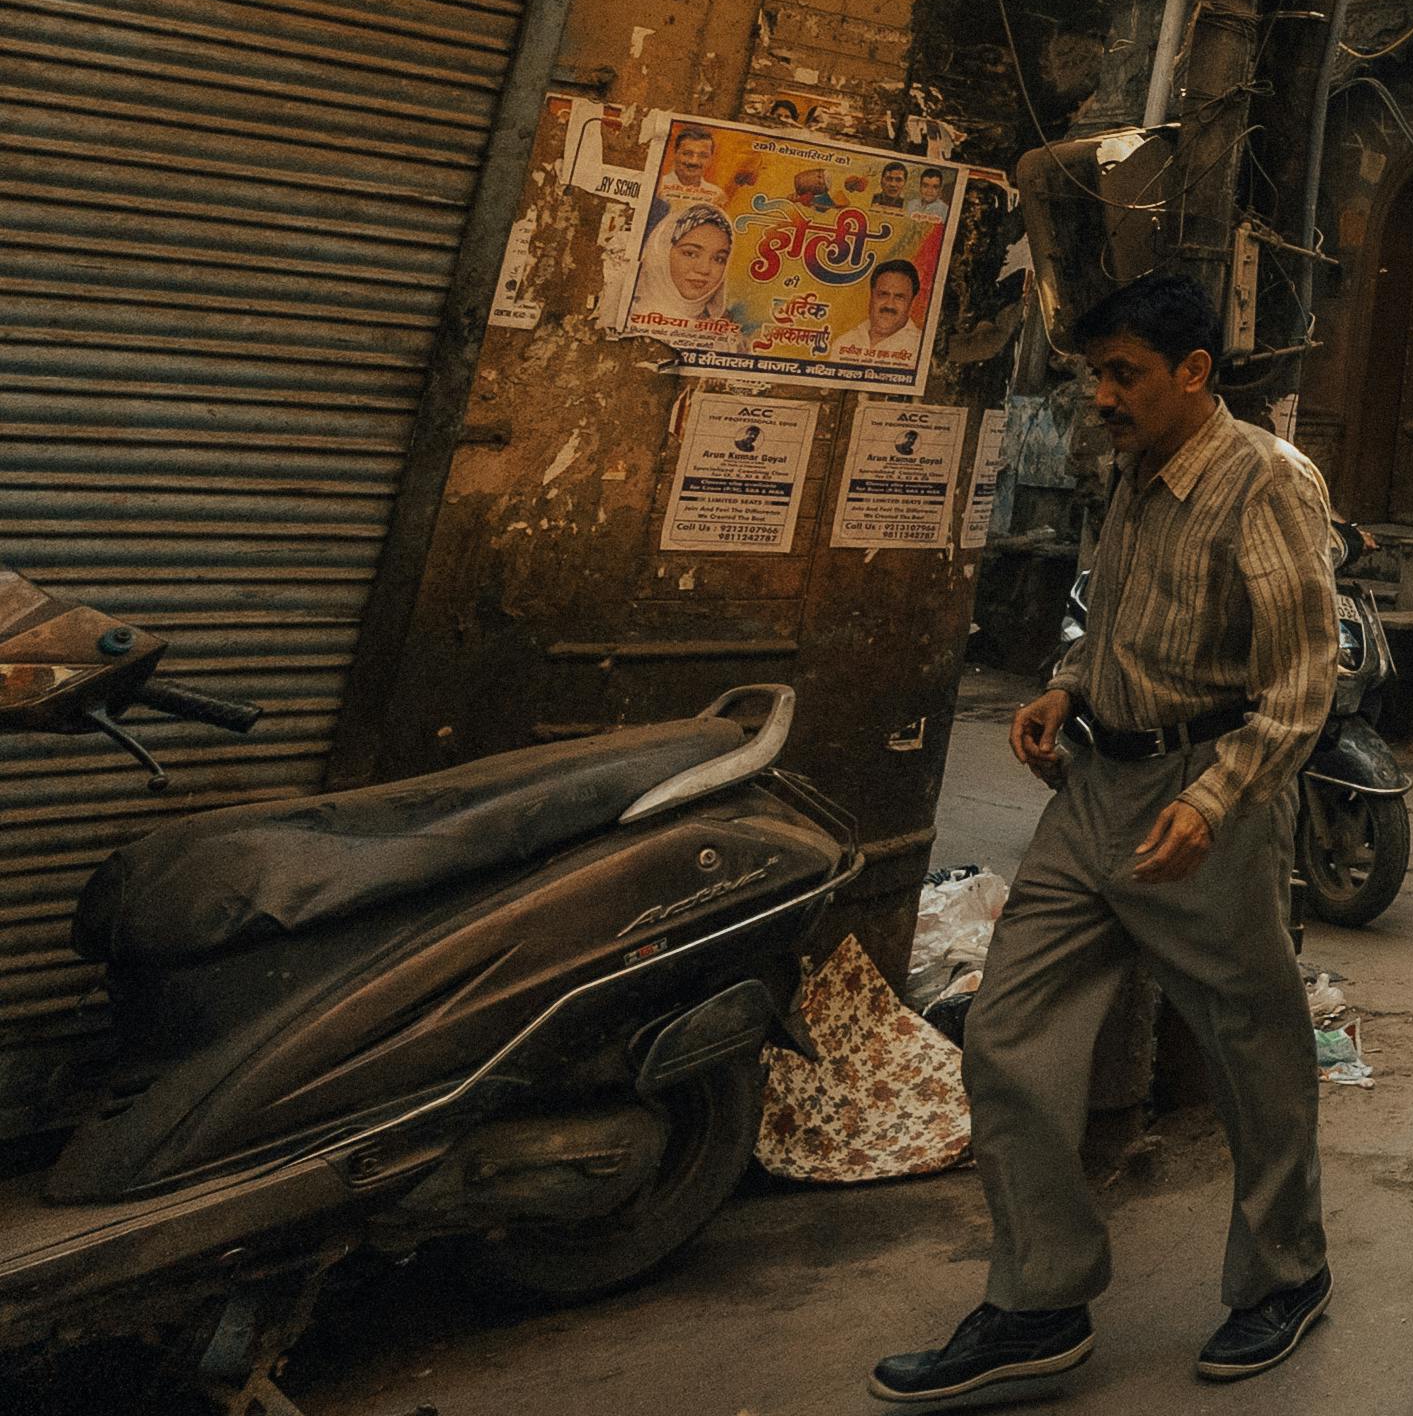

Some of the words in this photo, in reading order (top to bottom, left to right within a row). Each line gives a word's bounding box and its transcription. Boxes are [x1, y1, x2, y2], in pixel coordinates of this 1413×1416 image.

[738, 407, 773, 418] ACC
[897, 413, 929, 423] ACC
[728, 452, 759, 461] Kumar
[676, 523, 696, 531] Call
